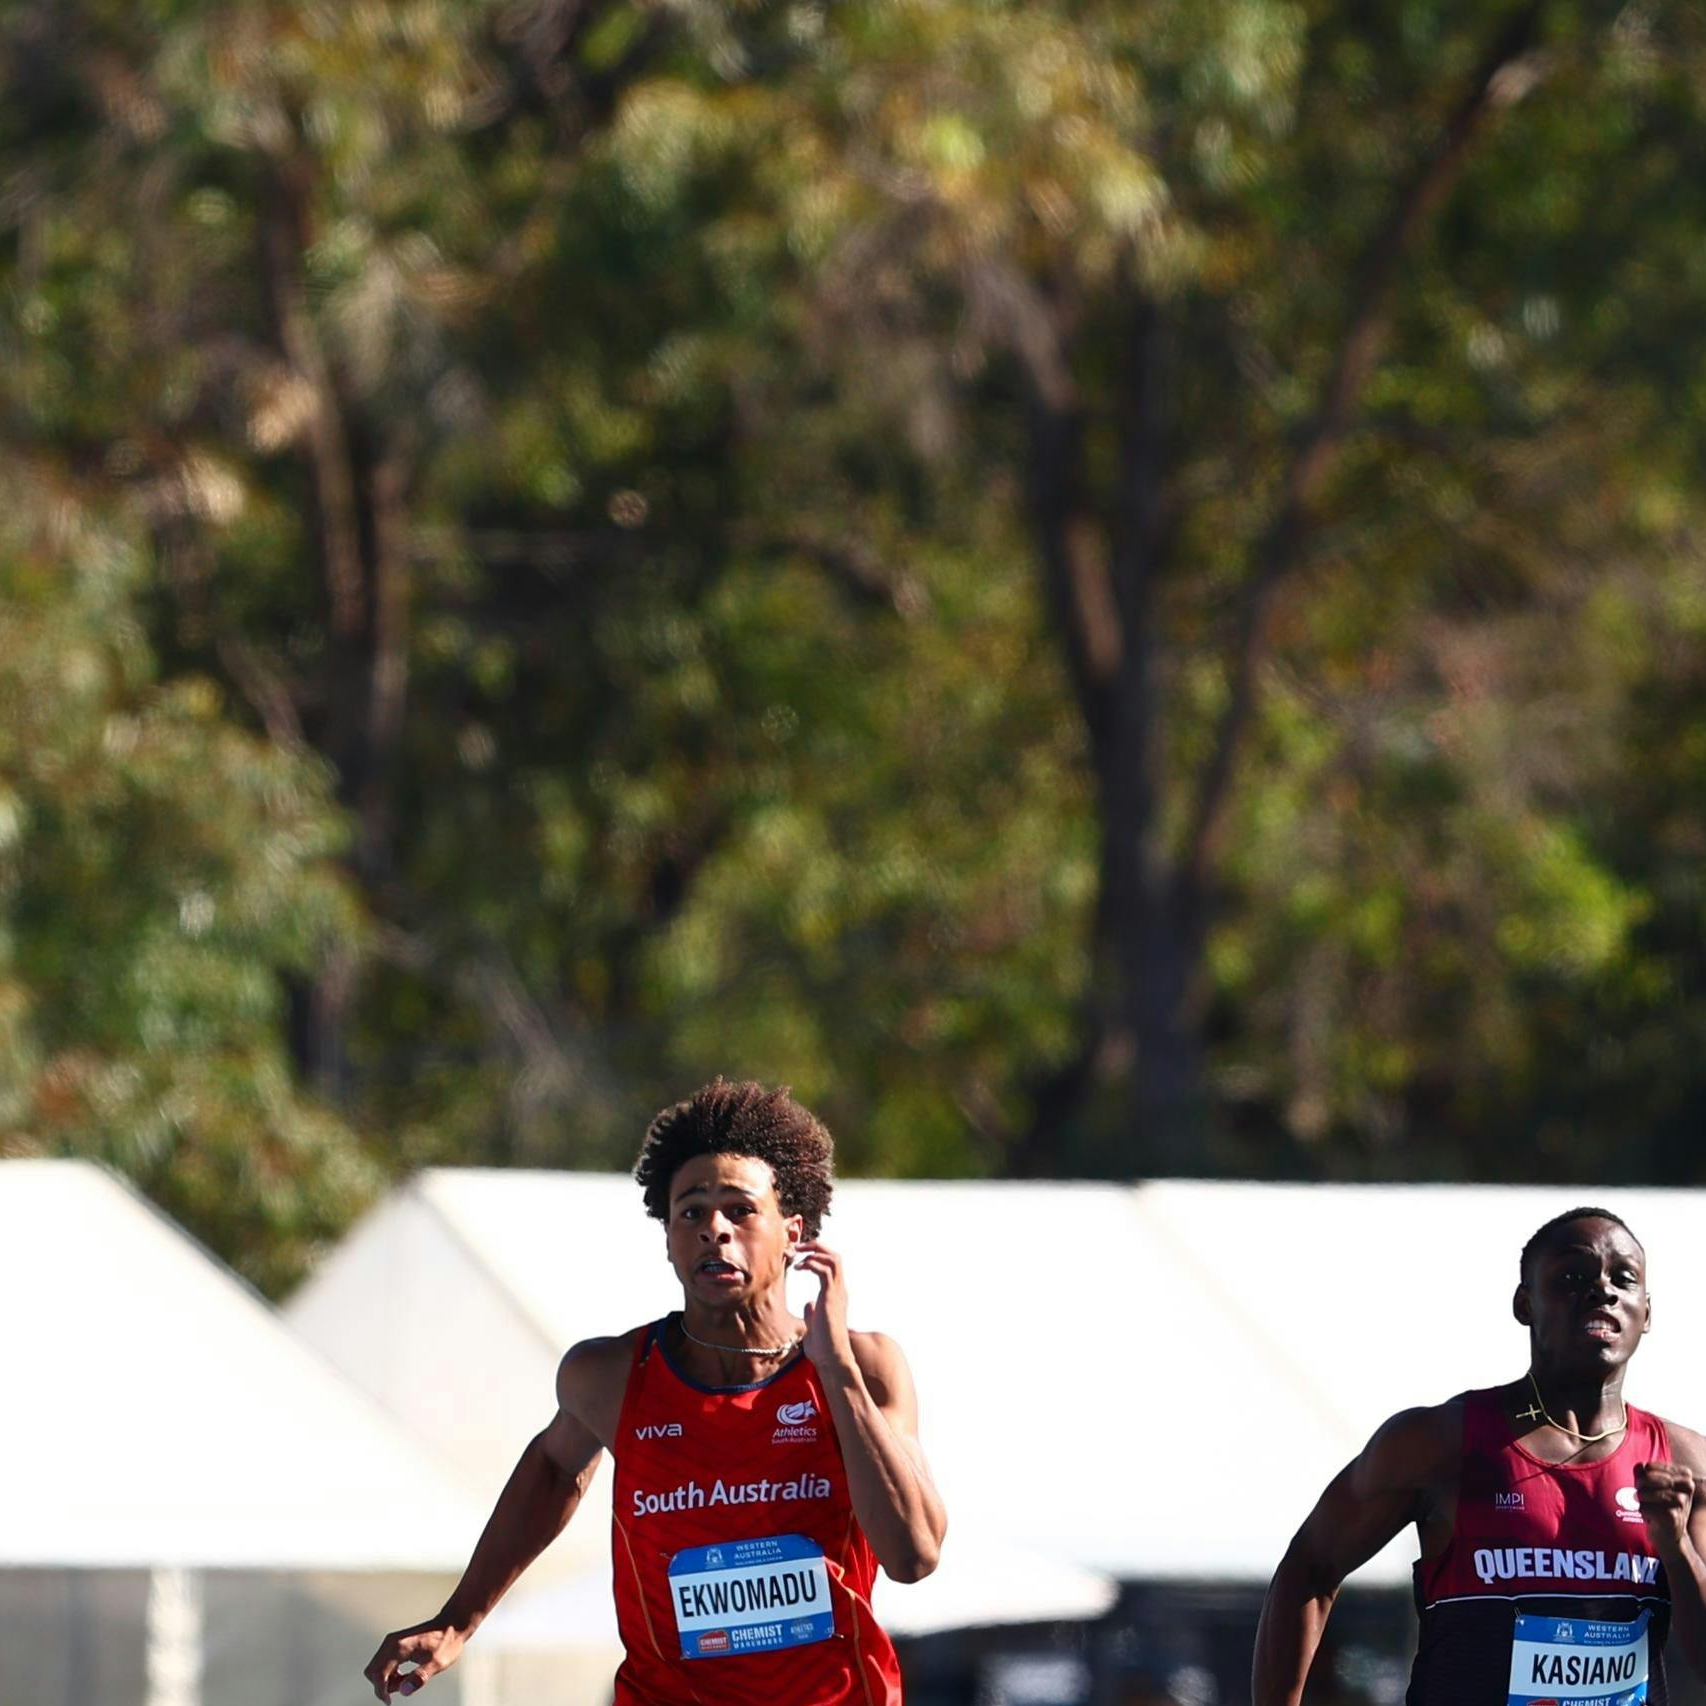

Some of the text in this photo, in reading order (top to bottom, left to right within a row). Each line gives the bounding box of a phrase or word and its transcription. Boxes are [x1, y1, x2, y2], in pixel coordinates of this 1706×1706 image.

[635, 1423, 683, 1440] viva
[632, 1472, 832, 1517] South Australia
[1495, 1492, 1524, 1505] IMPI
[733, 1548, 782, 1560] AUSTRALIA
[736, 1540, 778, 1551] WESTERN
[678, 1569, 817, 1618] EKWOMADU
[731, 1624, 783, 1642] CHEMIST
[1588, 1624, 1630, 1632] WESTERN
[1531, 1650, 1637, 1686] KASIANO
